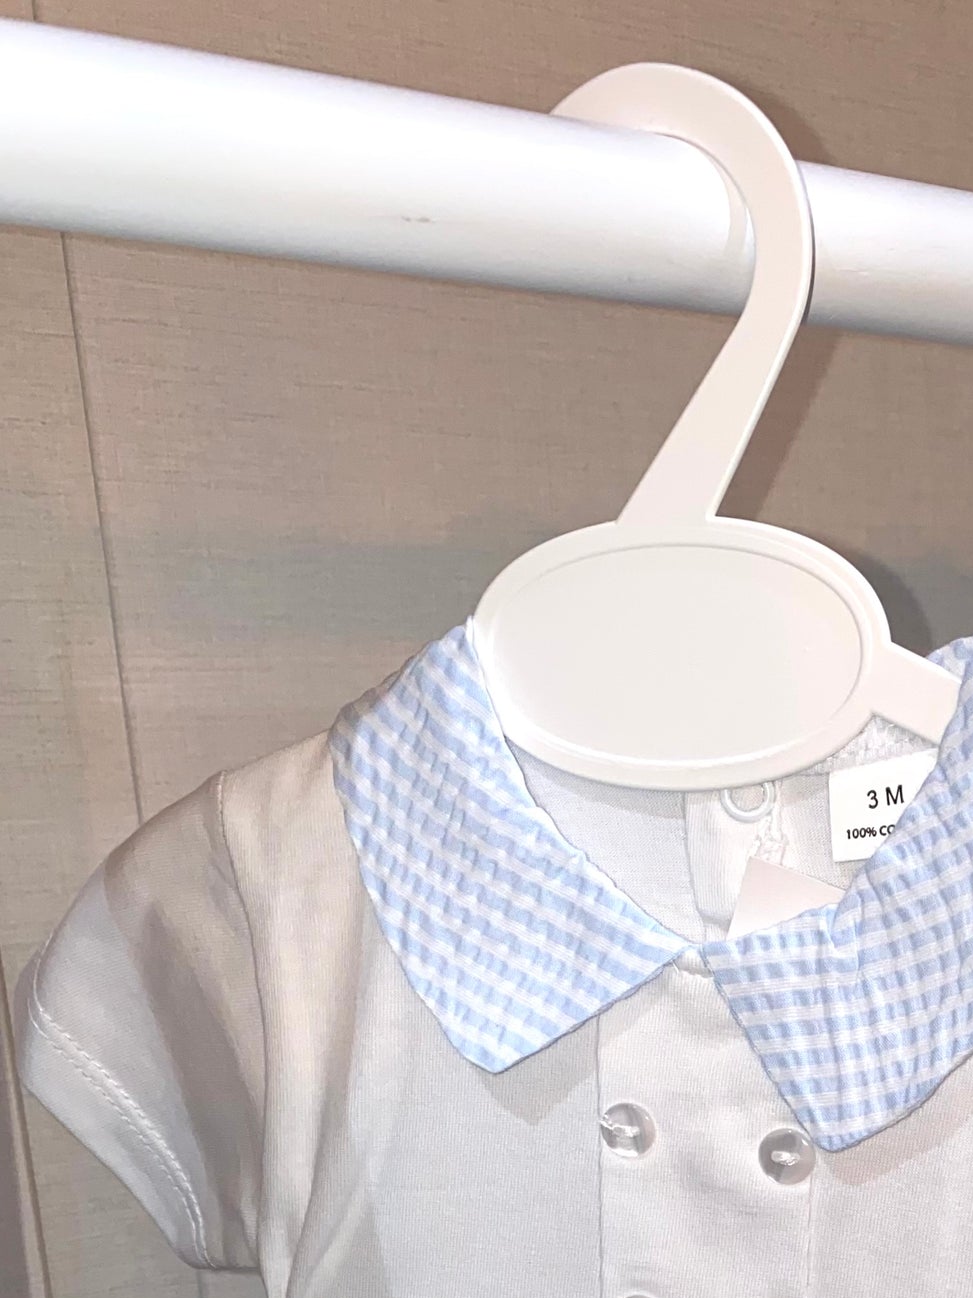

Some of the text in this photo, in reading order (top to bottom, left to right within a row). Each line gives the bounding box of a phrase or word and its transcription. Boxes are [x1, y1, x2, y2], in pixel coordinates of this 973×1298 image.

[866, 784, 905, 809] 3 M
[846, 826, 877, 840] 100%
